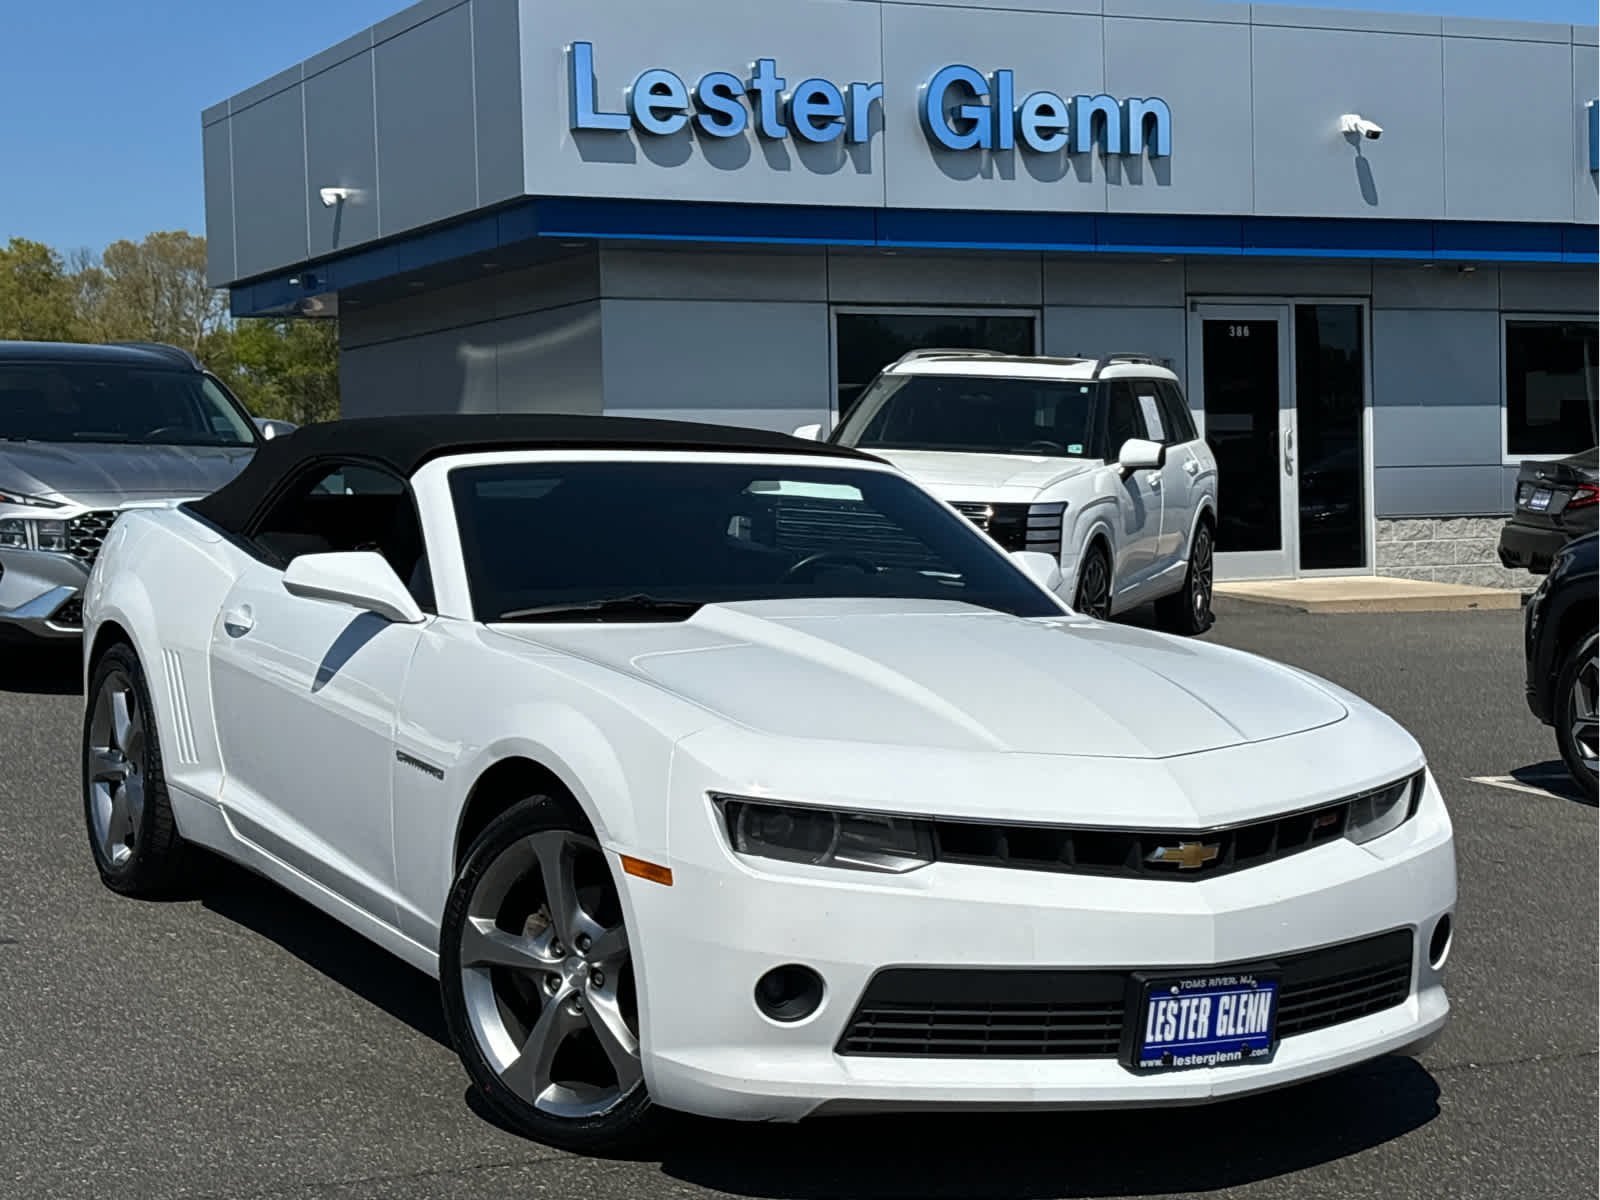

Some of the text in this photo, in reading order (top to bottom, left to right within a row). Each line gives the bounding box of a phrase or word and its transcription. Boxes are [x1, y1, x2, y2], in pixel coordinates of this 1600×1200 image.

[568, 41, 1172, 157] Lester Glenn
[1229, 325, 1250, 337] 386
[1180, 980, 1207, 990] TOMS
[1145, 992, 1272, 1043] LESTER GLENN
